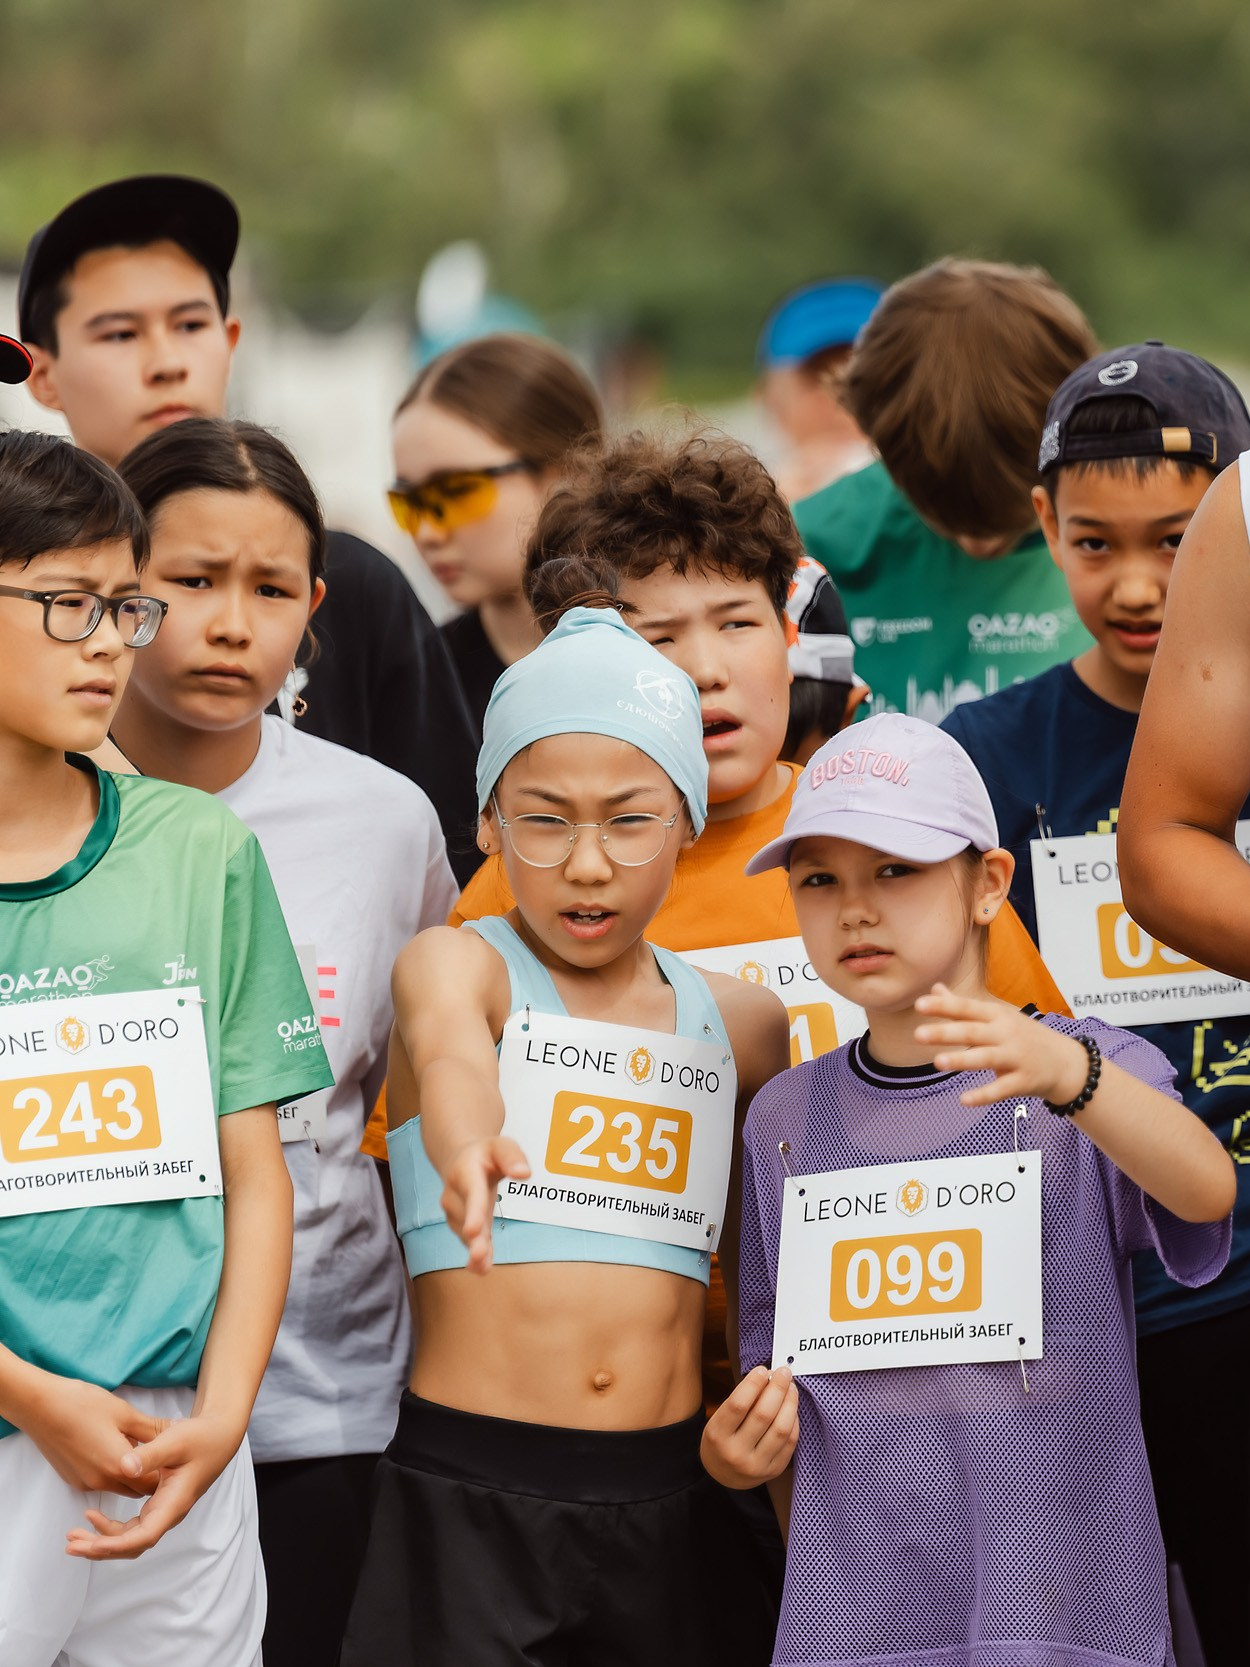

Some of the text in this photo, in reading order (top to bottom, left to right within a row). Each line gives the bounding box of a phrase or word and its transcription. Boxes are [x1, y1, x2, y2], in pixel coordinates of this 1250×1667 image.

[1059, 863, 1119, 885] LEO
[1073, 979, 1242, 1008] БЛАГОТВОРИТЕЛЬНЫЙ
[99, 1018, 178, 1045] D'ORO
[525, 1040, 720, 1093] LEONE D'ORO
[13, 1078, 143, 1151] 243
[561, 1105, 679, 1180] 235
[153, 1160, 194, 1176] ЗАБЕГ
[507, 1181, 706, 1225] БЛАГОТВОРИТЕЛЬНЫЙ ЗАБЕГ
[803, 1181, 1016, 1222] LEONE D'ORO
[845, 1241, 965, 1309] 099
[799, 1323, 1014, 1351] БЛАГОТВОРИТЕЛЬНЫЙ ЗАБЕГ
